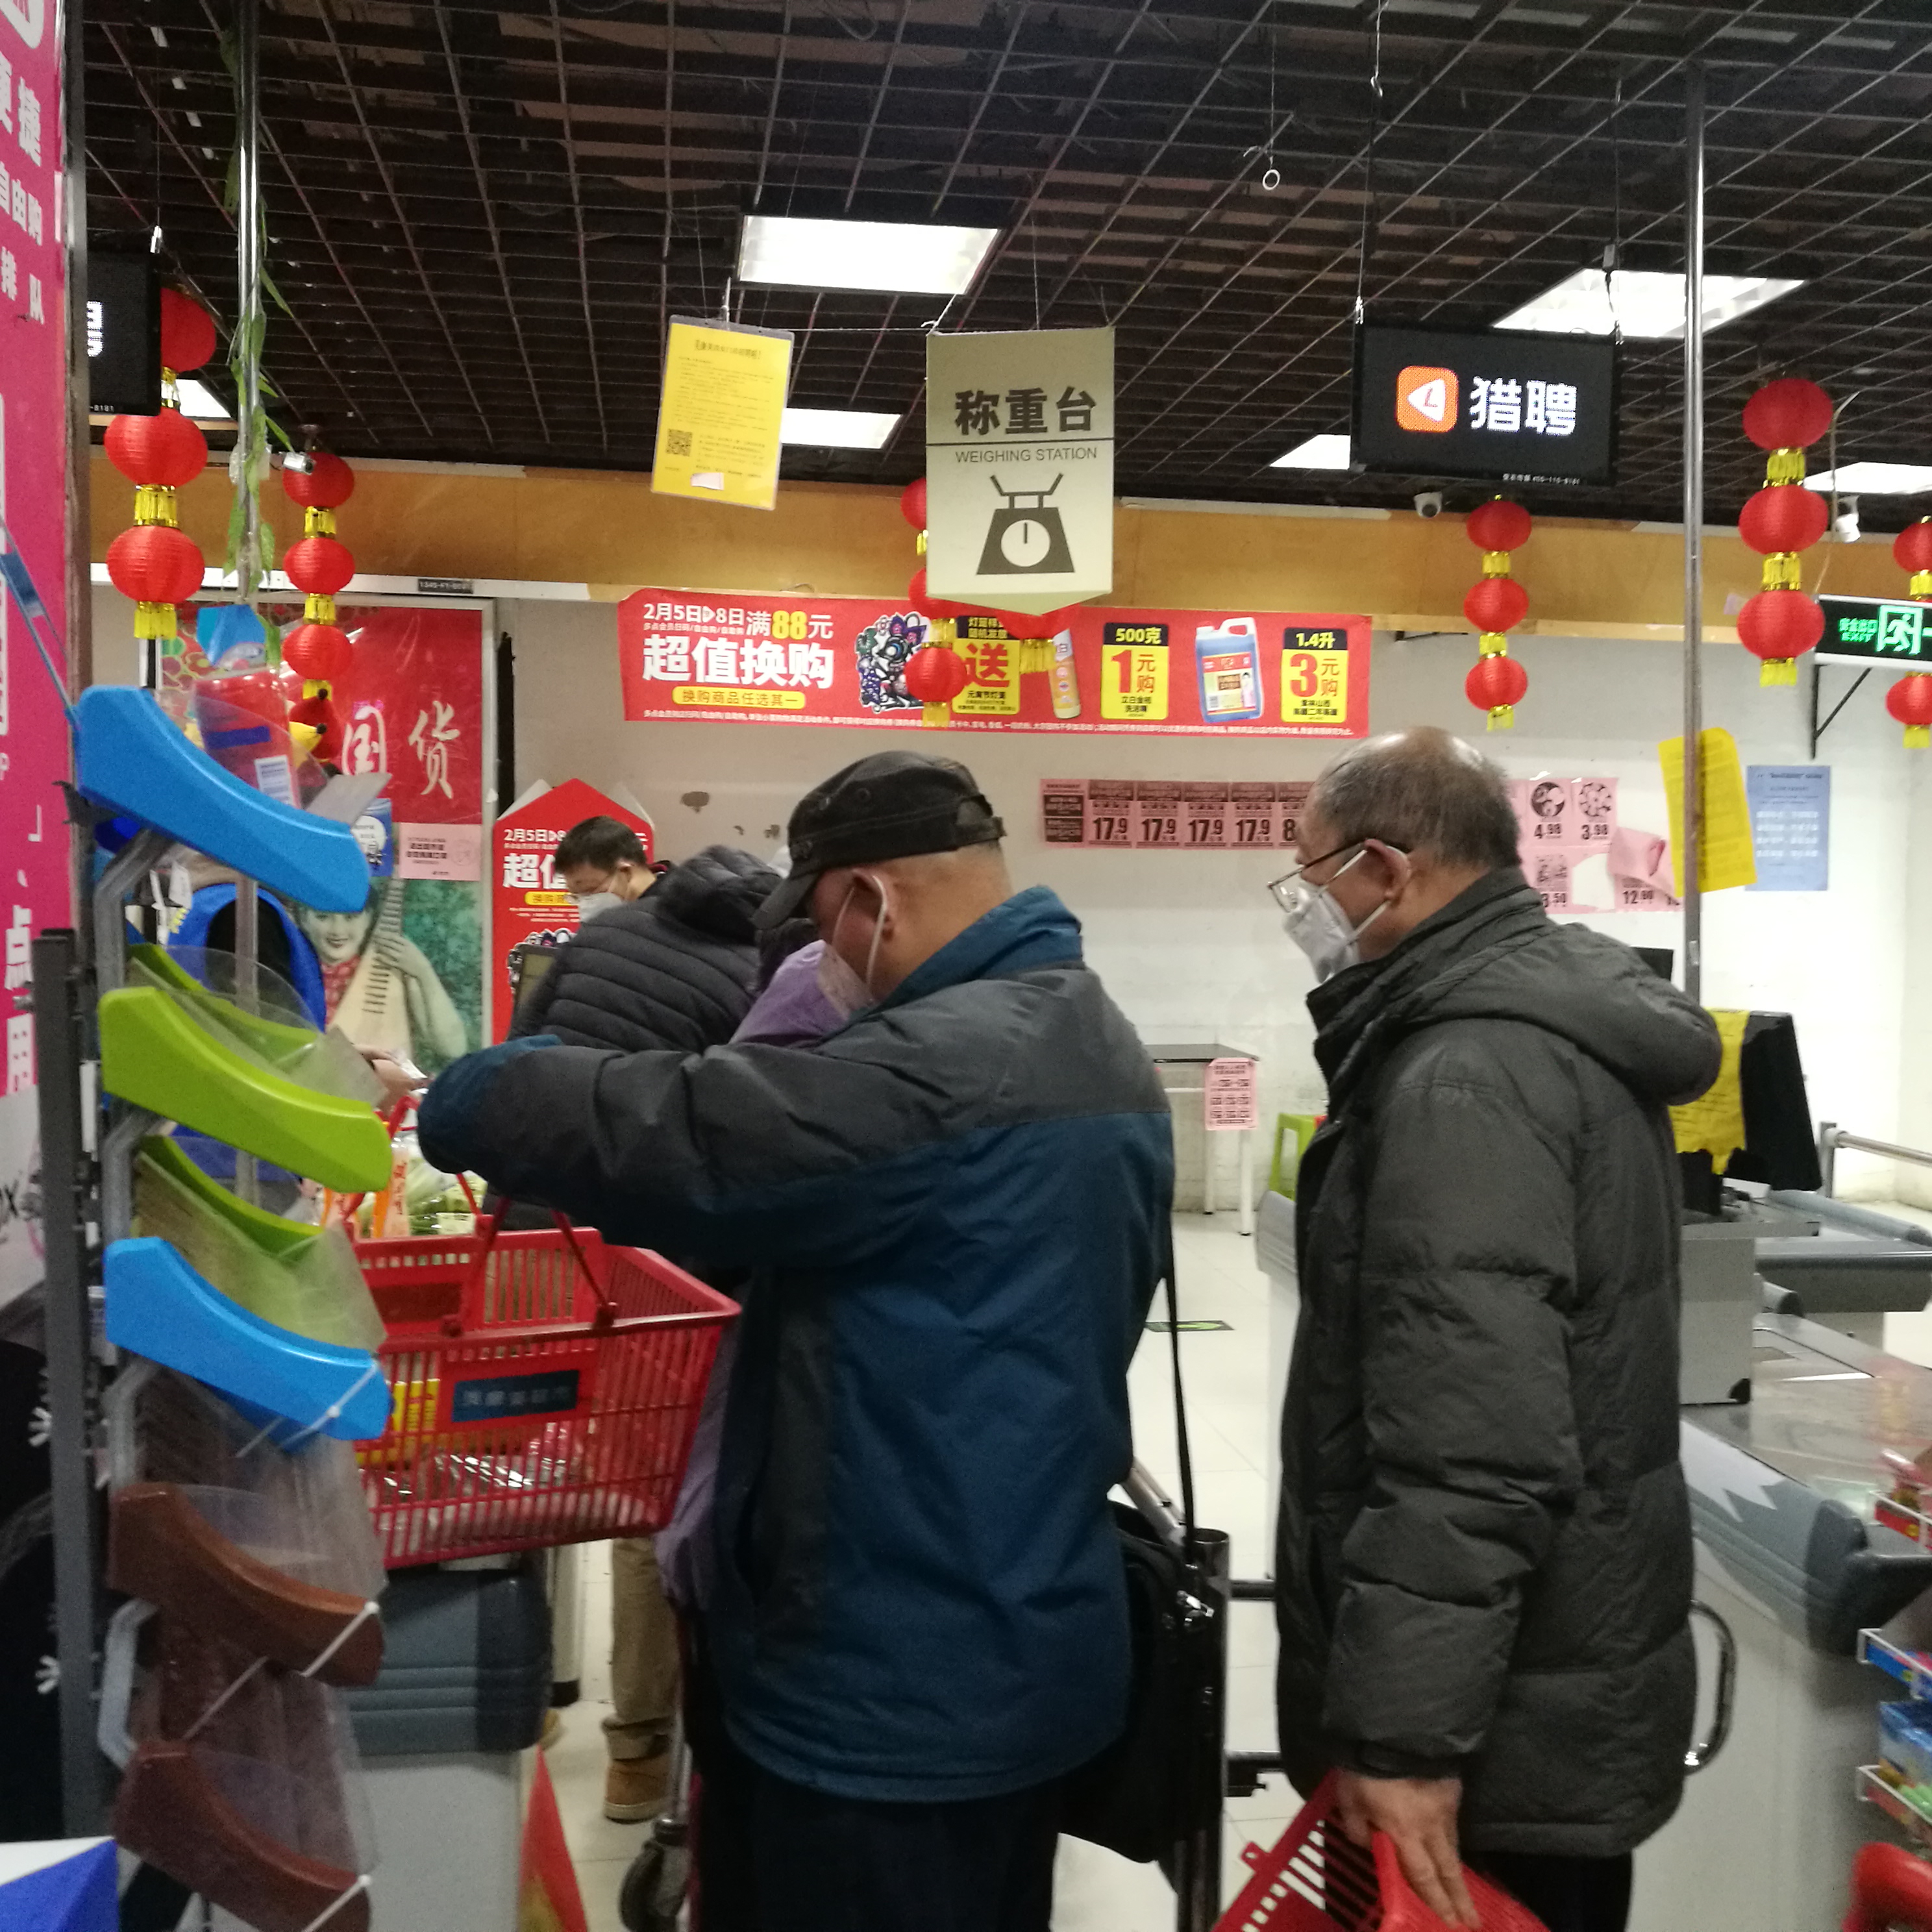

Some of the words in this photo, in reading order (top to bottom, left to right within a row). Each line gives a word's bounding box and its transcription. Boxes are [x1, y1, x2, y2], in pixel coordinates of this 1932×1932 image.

[954, 386, 1096, 436] 称重台
[1469, 376, 1578, 436] 猎聘
[956, 449, 1031, 463] WEIGHING
[1036, 447, 1097, 461] STATION
[1115, 627, 1161, 644] 500克
[1296, 632, 1336, 649] 1.4升
[643, 634, 834, 689] 超值换购
[965, 643, 1009, 687] 送
[682, 689, 799, 706] 换购商品任选其一
